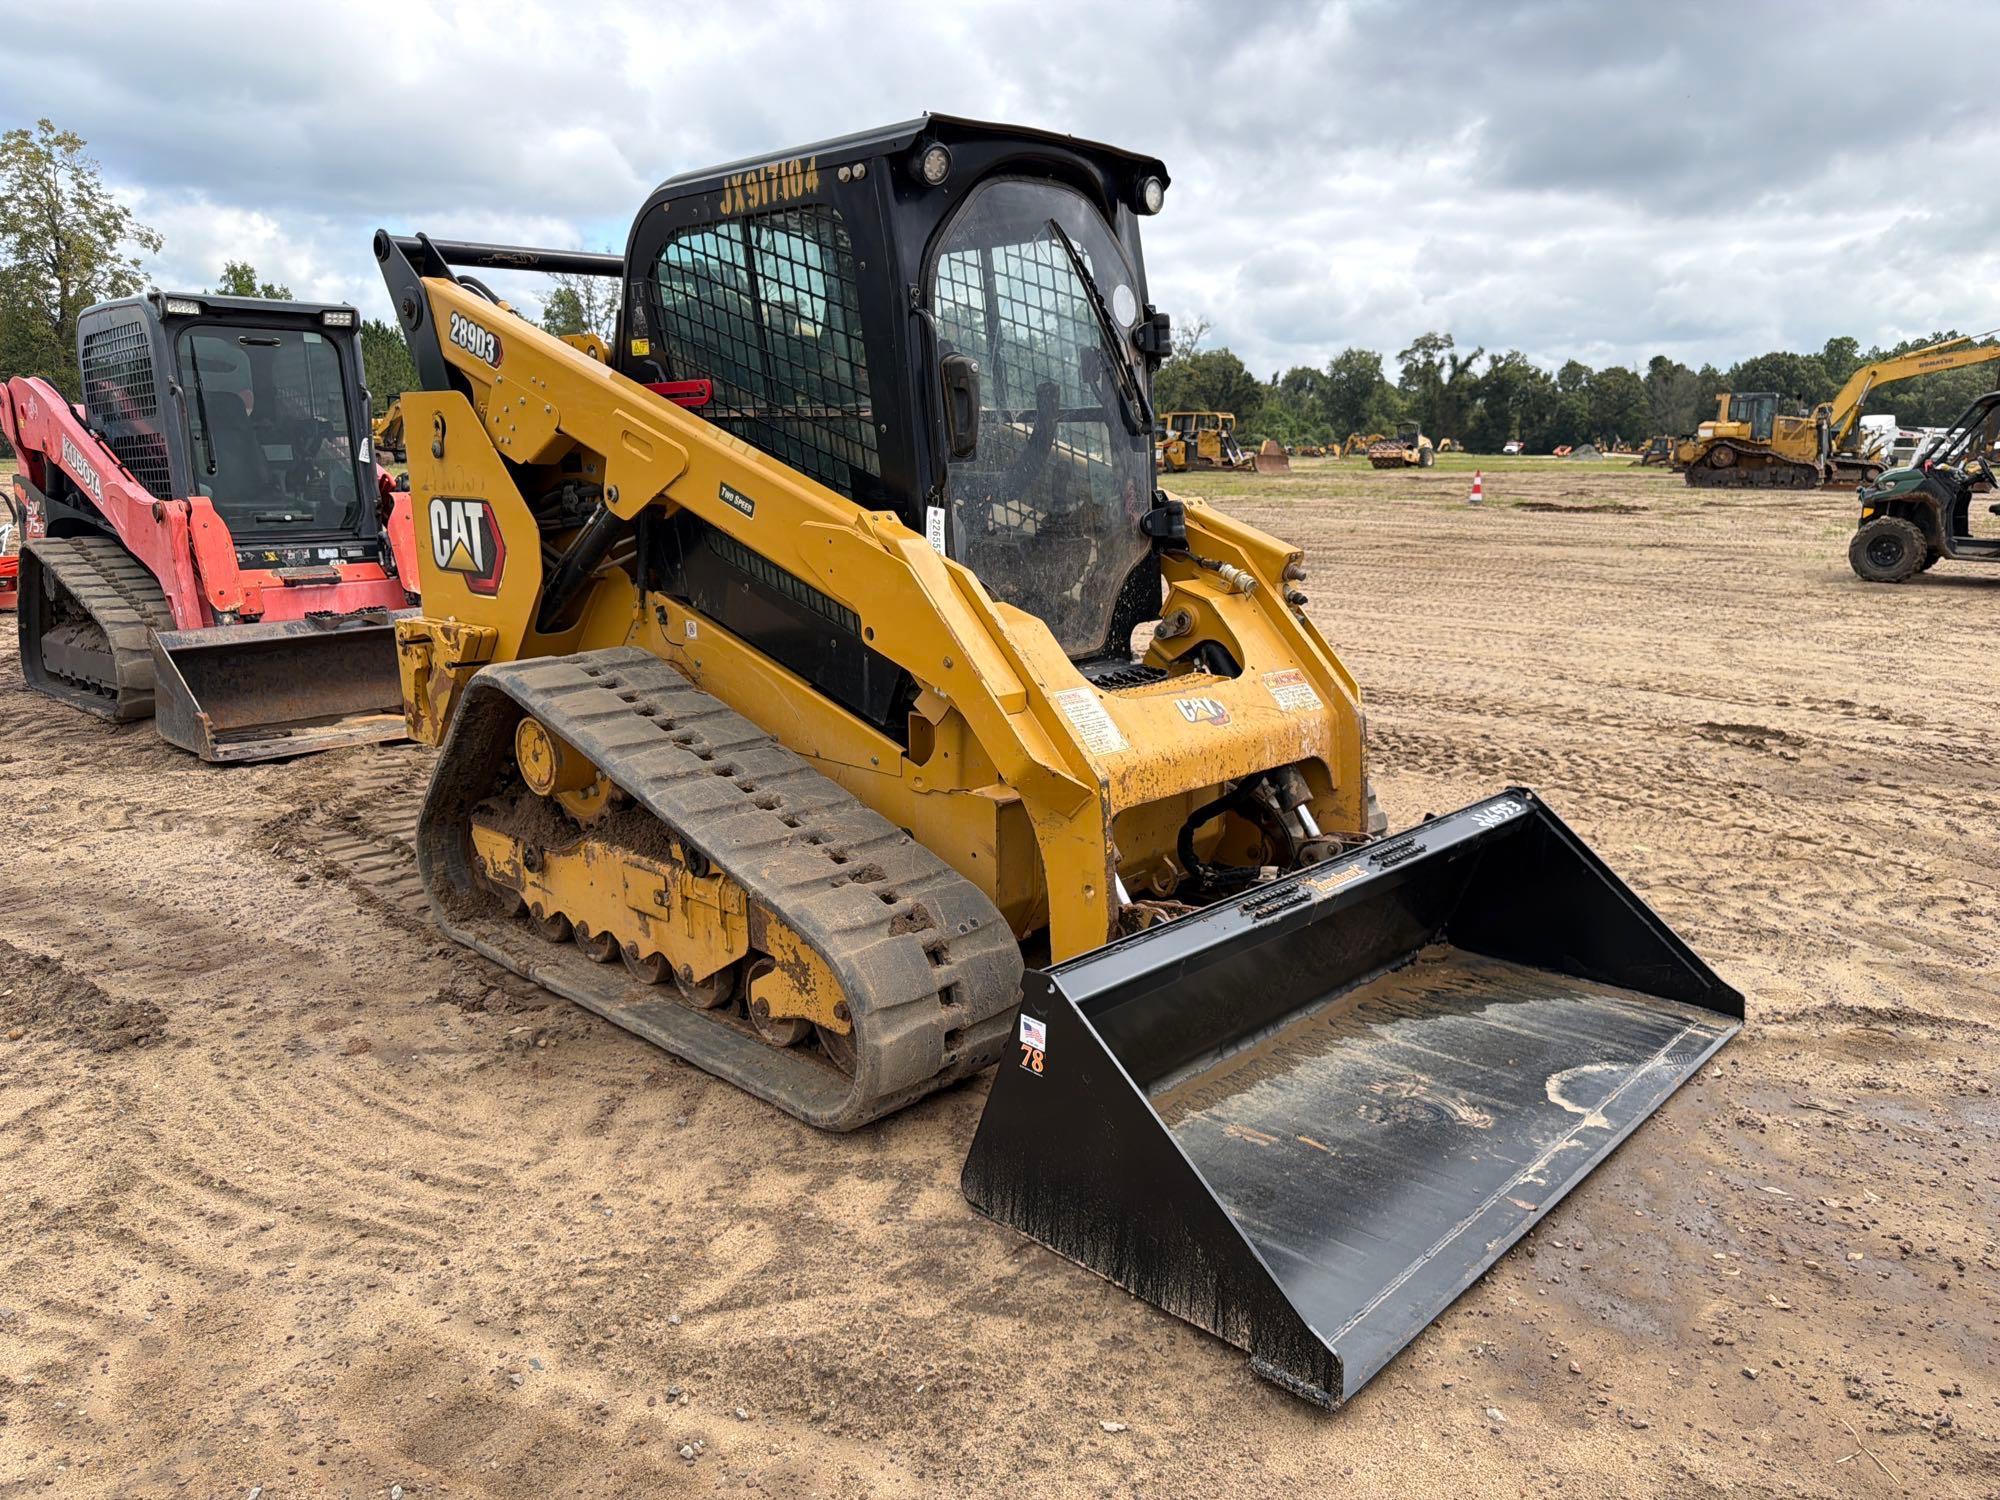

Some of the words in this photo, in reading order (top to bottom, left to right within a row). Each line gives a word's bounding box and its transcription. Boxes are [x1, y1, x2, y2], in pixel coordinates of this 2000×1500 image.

[720, 156, 819, 216] JX917104
[450, 313, 495, 364] 289D3
[63, 438, 102, 500] KUBOTA
[430, 499, 485, 573] CAT
[1174, 696, 1219, 723] CAT
[1020, 1043, 1044, 1073] 78
